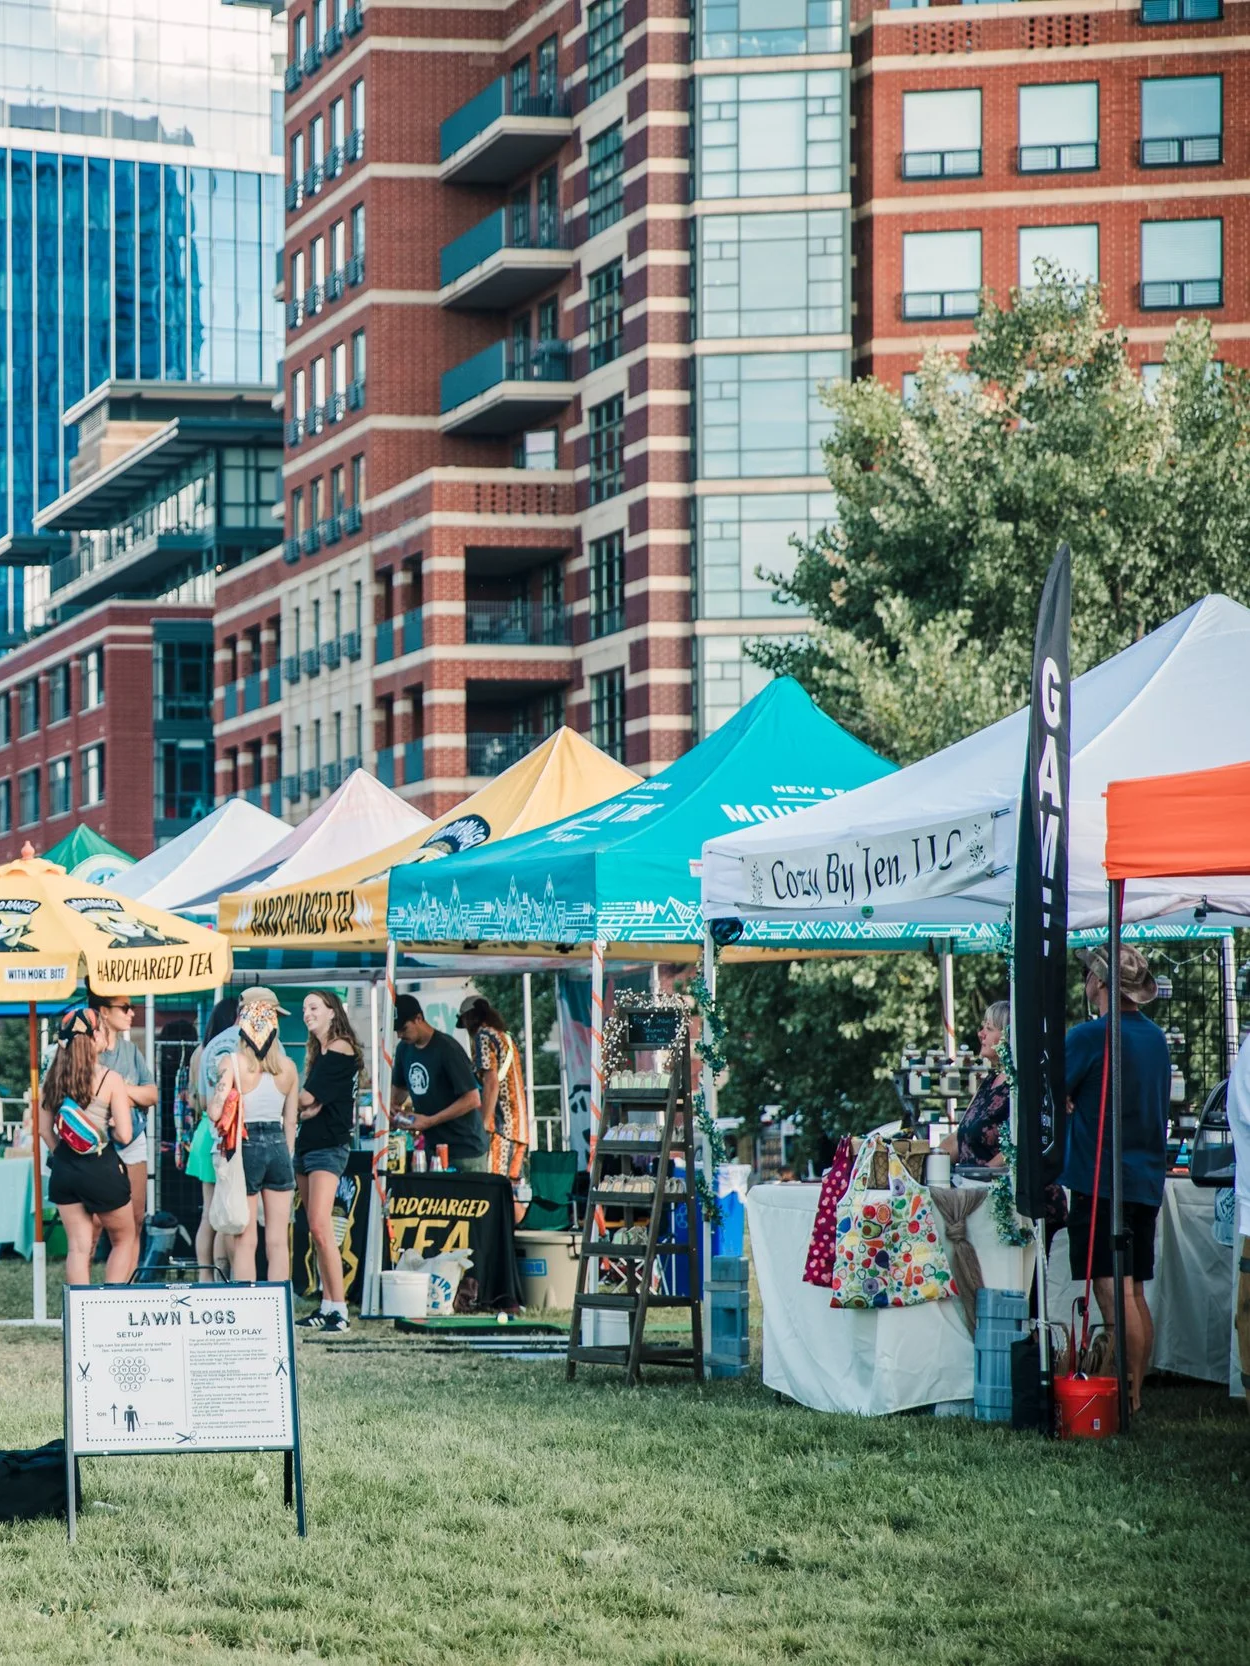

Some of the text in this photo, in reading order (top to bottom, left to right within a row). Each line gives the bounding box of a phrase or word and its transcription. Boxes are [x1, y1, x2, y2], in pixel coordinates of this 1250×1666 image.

[771, 785, 815, 795] NEW
[771, 860, 823, 907] Cozy
[826, 852, 856, 905] By
[251, 889, 355, 937] HARDCHARGED TEA
[7, 967, 65, 980] WITH MORE BITE
[97, 951, 214, 983] HARDCHARGED TEA
[388, 1196, 491, 1218] ARDCHARGED
[128, 1310, 236, 1326] LAWN LOGS
[116, 1331, 144, 1339] SETUP
[229, 1328, 240, 1336] TO
